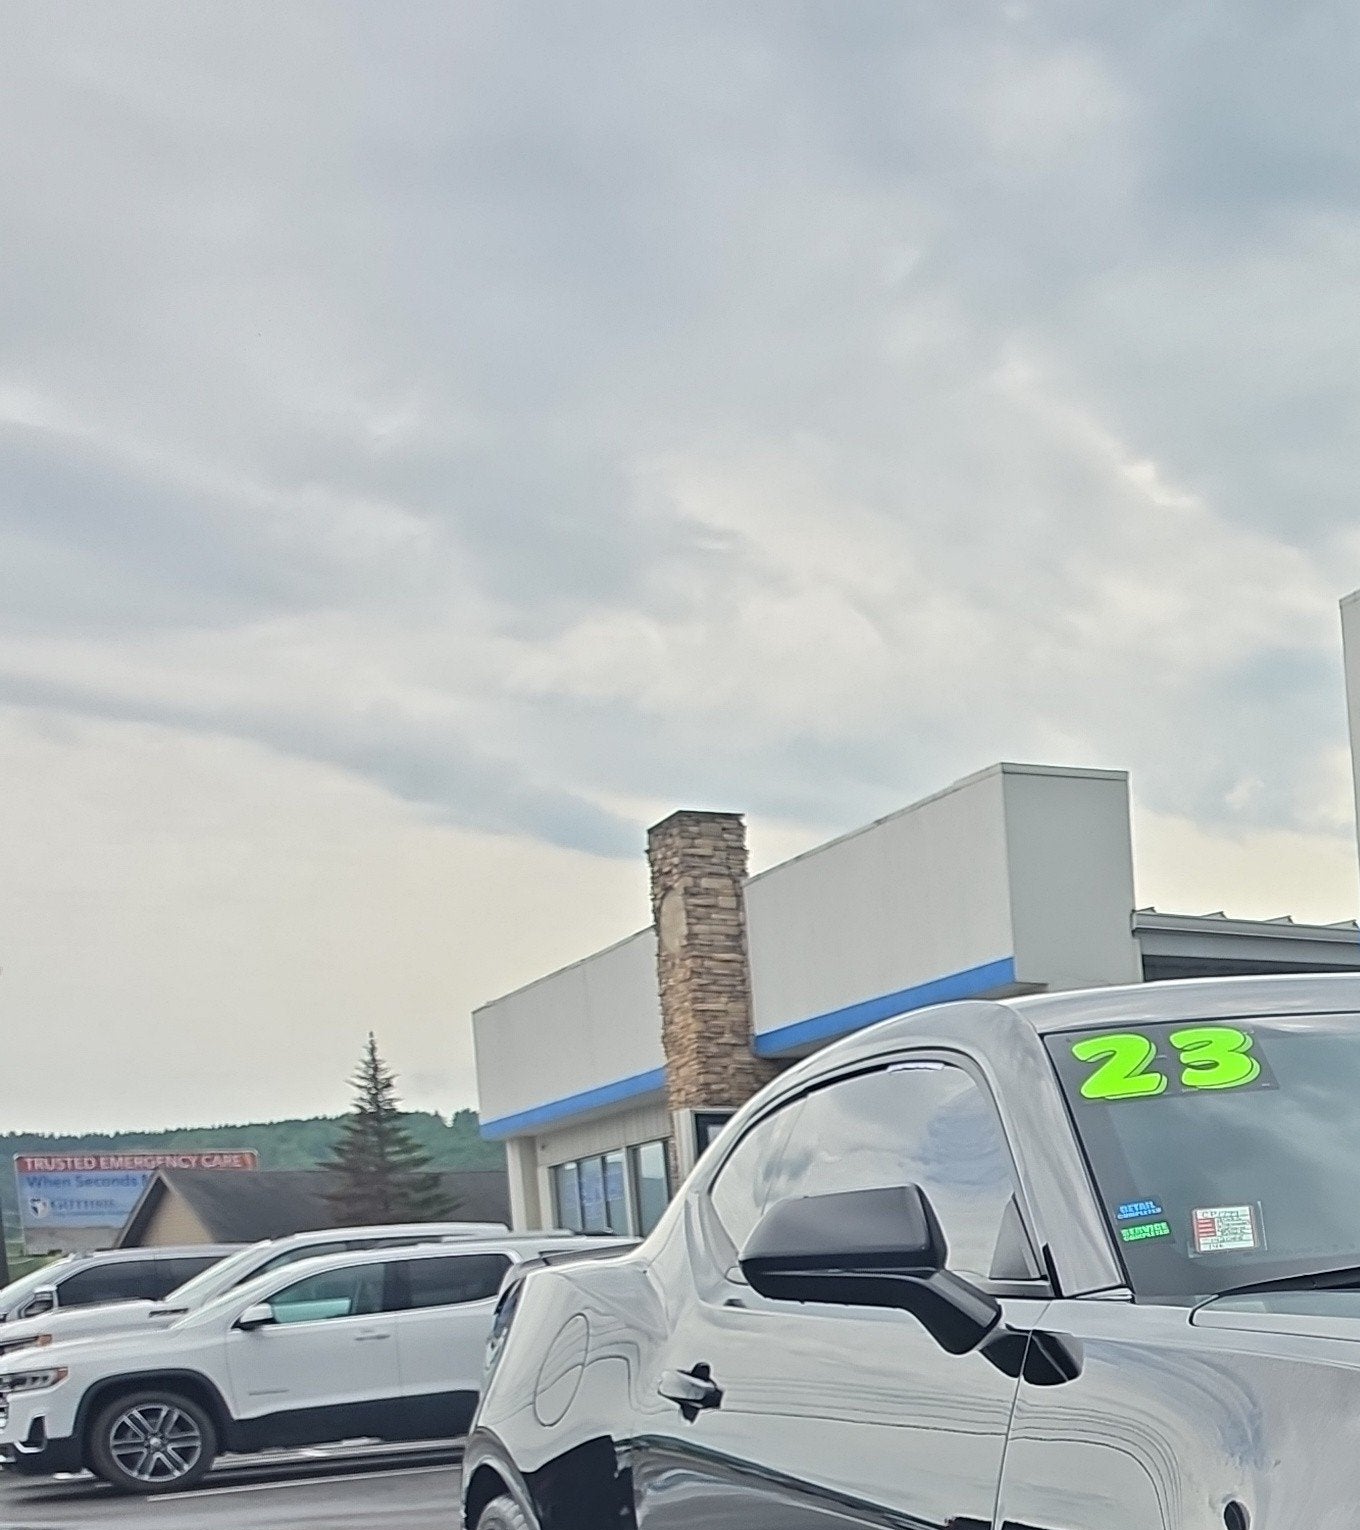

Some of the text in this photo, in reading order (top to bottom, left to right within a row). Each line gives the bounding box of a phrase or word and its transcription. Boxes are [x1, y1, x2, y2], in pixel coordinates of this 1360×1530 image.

[1072, 1026, 1260, 1100] 23
[26, 1154, 242, 1171] TRUSTED EMERGENCY CARE
[27, 1175, 70, 1188] When
[74, 1175, 137, 1188] Seconds
